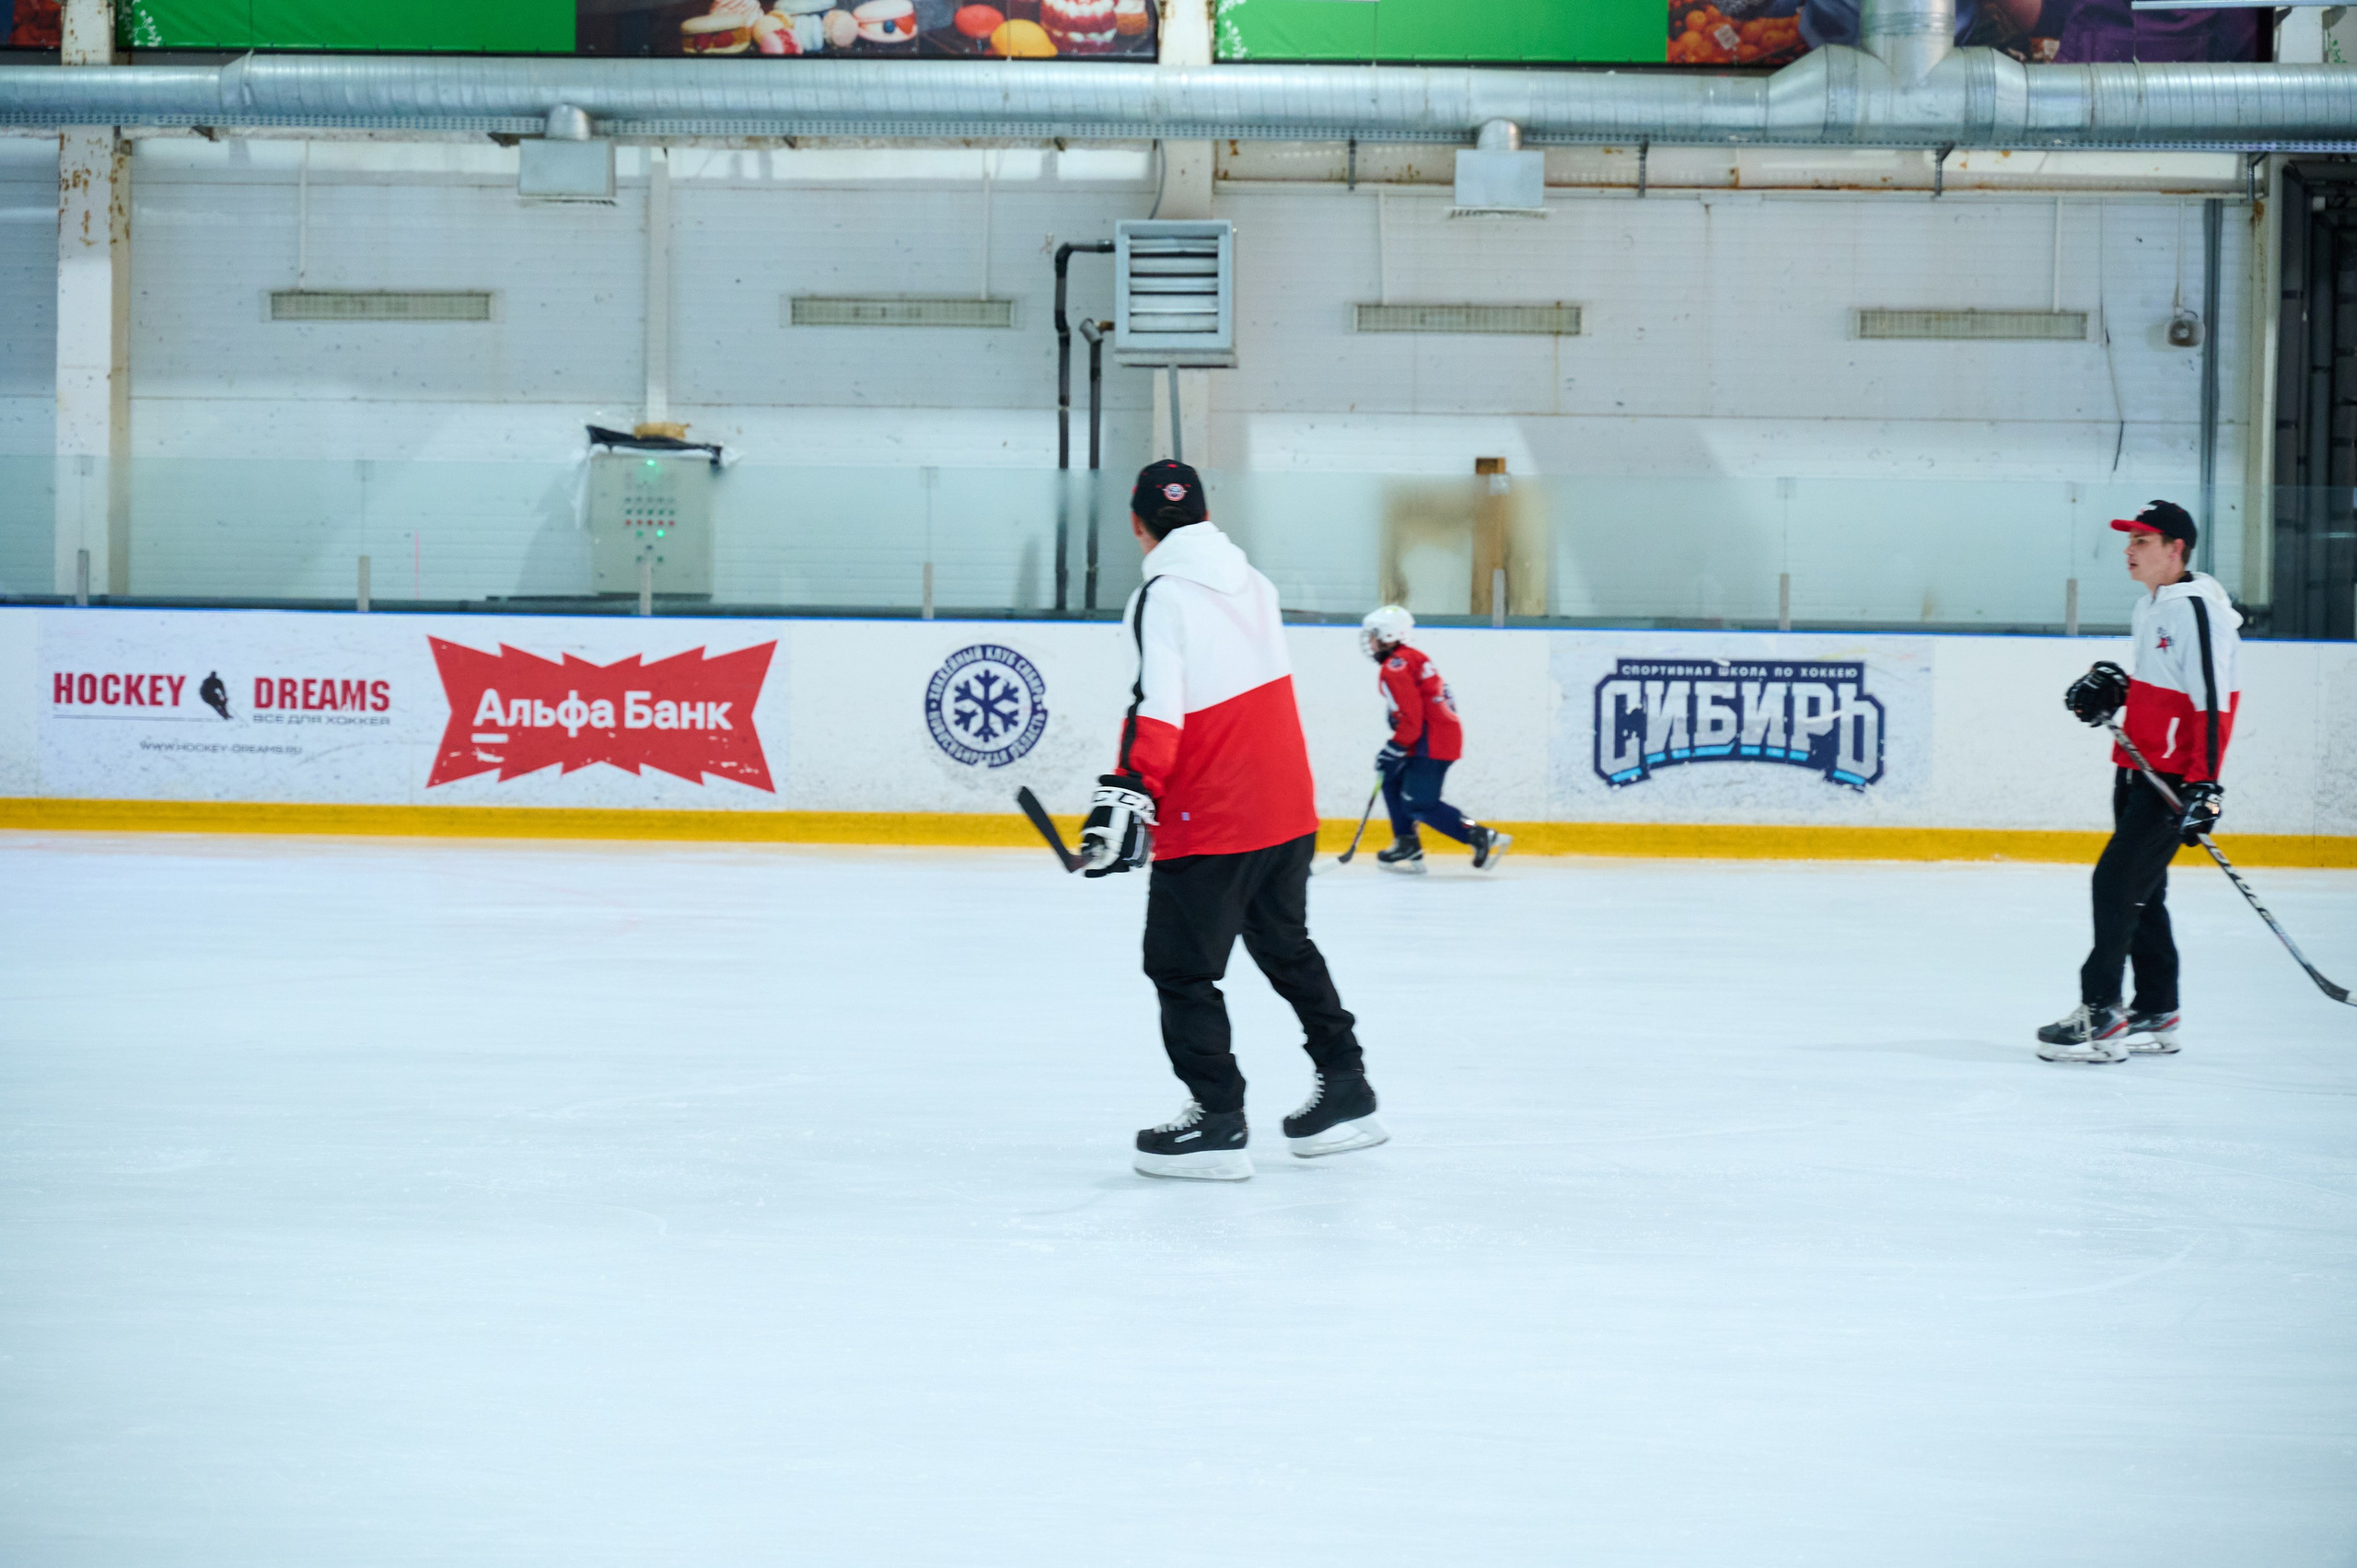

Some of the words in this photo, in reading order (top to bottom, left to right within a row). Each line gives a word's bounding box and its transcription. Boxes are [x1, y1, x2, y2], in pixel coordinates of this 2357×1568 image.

[985, 646, 1017, 666] КЛУБ
[1621, 664, 1712, 677] СПОРТИВНАЯ
[1718, 665, 1768, 678] ШКОЛА
[1774, 666, 1794, 678] ПО
[1801, 667, 1858, 679] ХОККЕЮ
[52, 672, 186, 706] HOCKEY
[254, 677, 390, 712] DREAMS
[253, 713, 284, 725] ВСЕ
[287, 714, 321, 726] ДЛЯ
[325, 714, 390, 726] ХОККЕЯ
[472, 688, 615, 737] Альфа
[624, 691, 733, 730] Банк
[1600, 679, 1879, 783] СИБИРЬ
